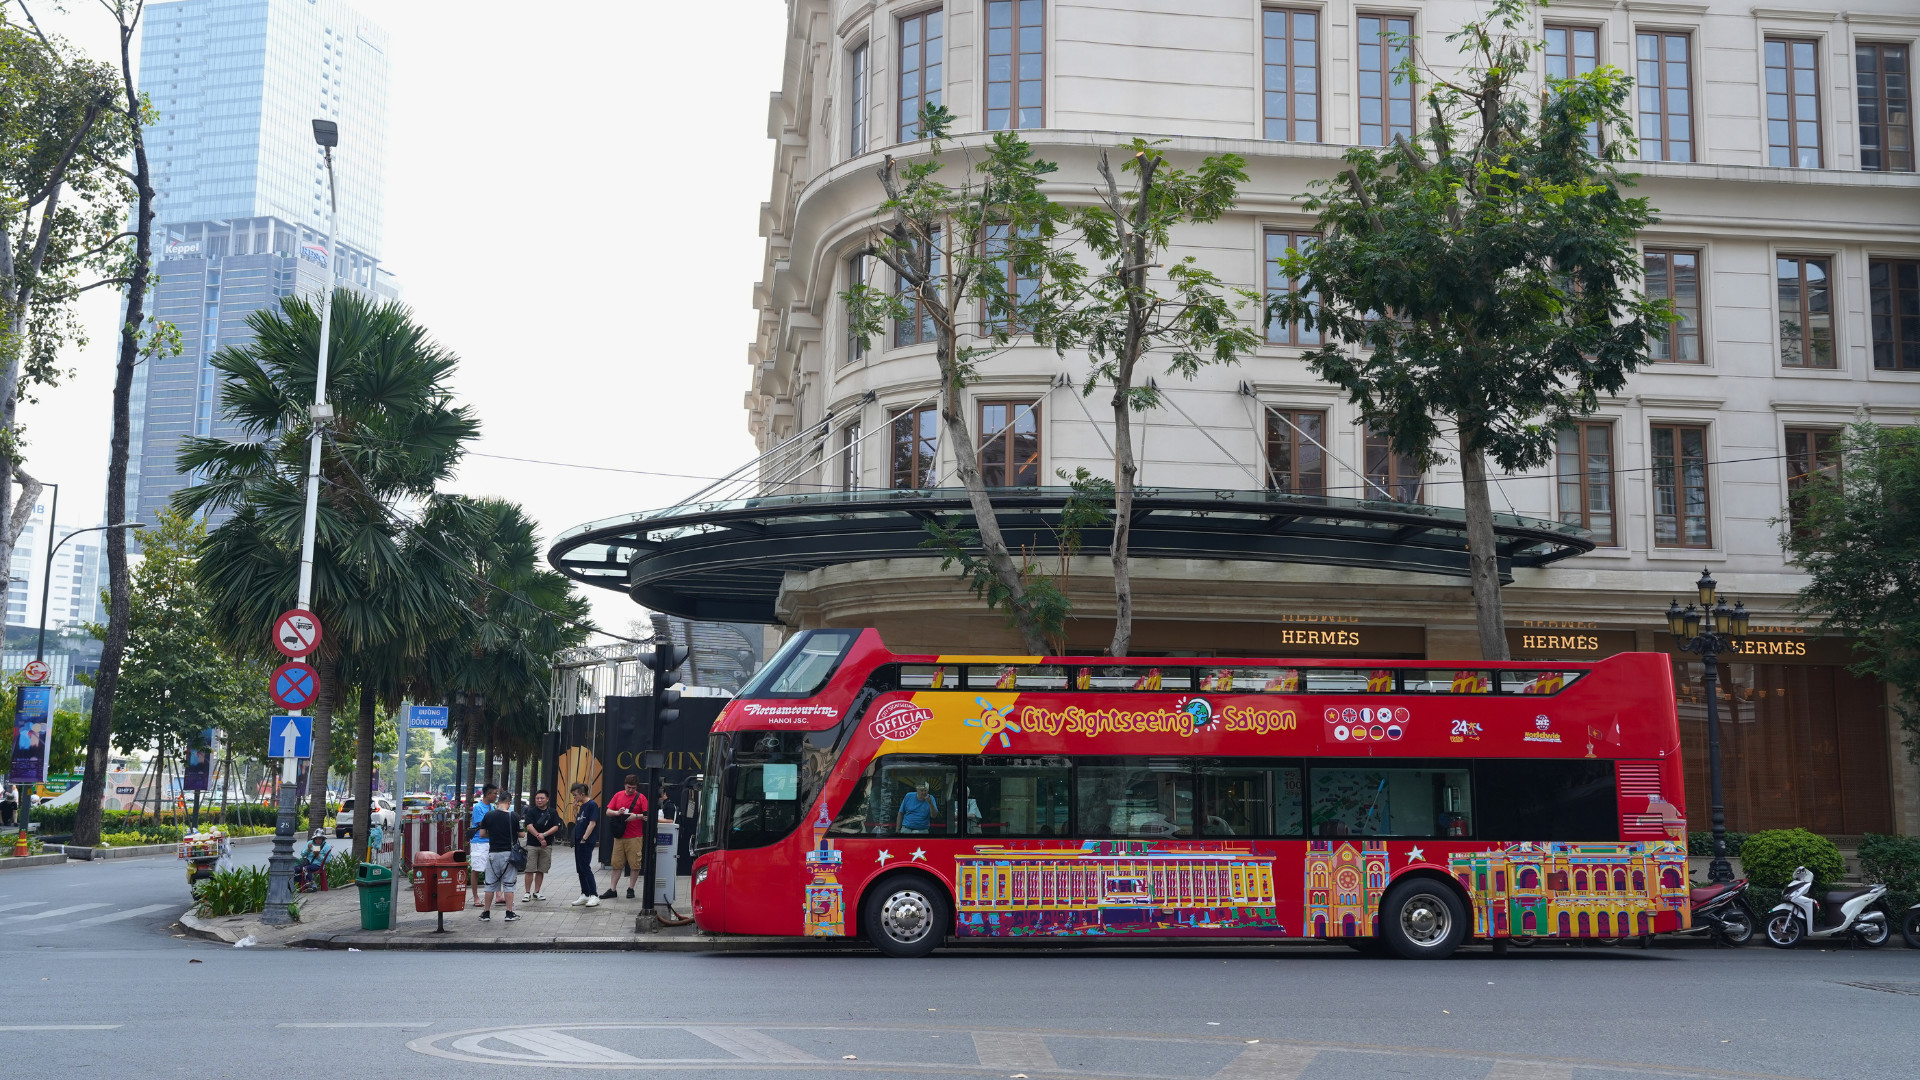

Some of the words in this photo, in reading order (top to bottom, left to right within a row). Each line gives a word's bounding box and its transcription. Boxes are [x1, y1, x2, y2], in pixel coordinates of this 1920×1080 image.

[165, 242, 200, 254] Keppel
[876, 710, 931, 734] OFFICIAL
[1223, 705, 1297, 735] Saigon
[1451, 719, 1468, 735] 24
[894, 724, 918, 738] TOUR
